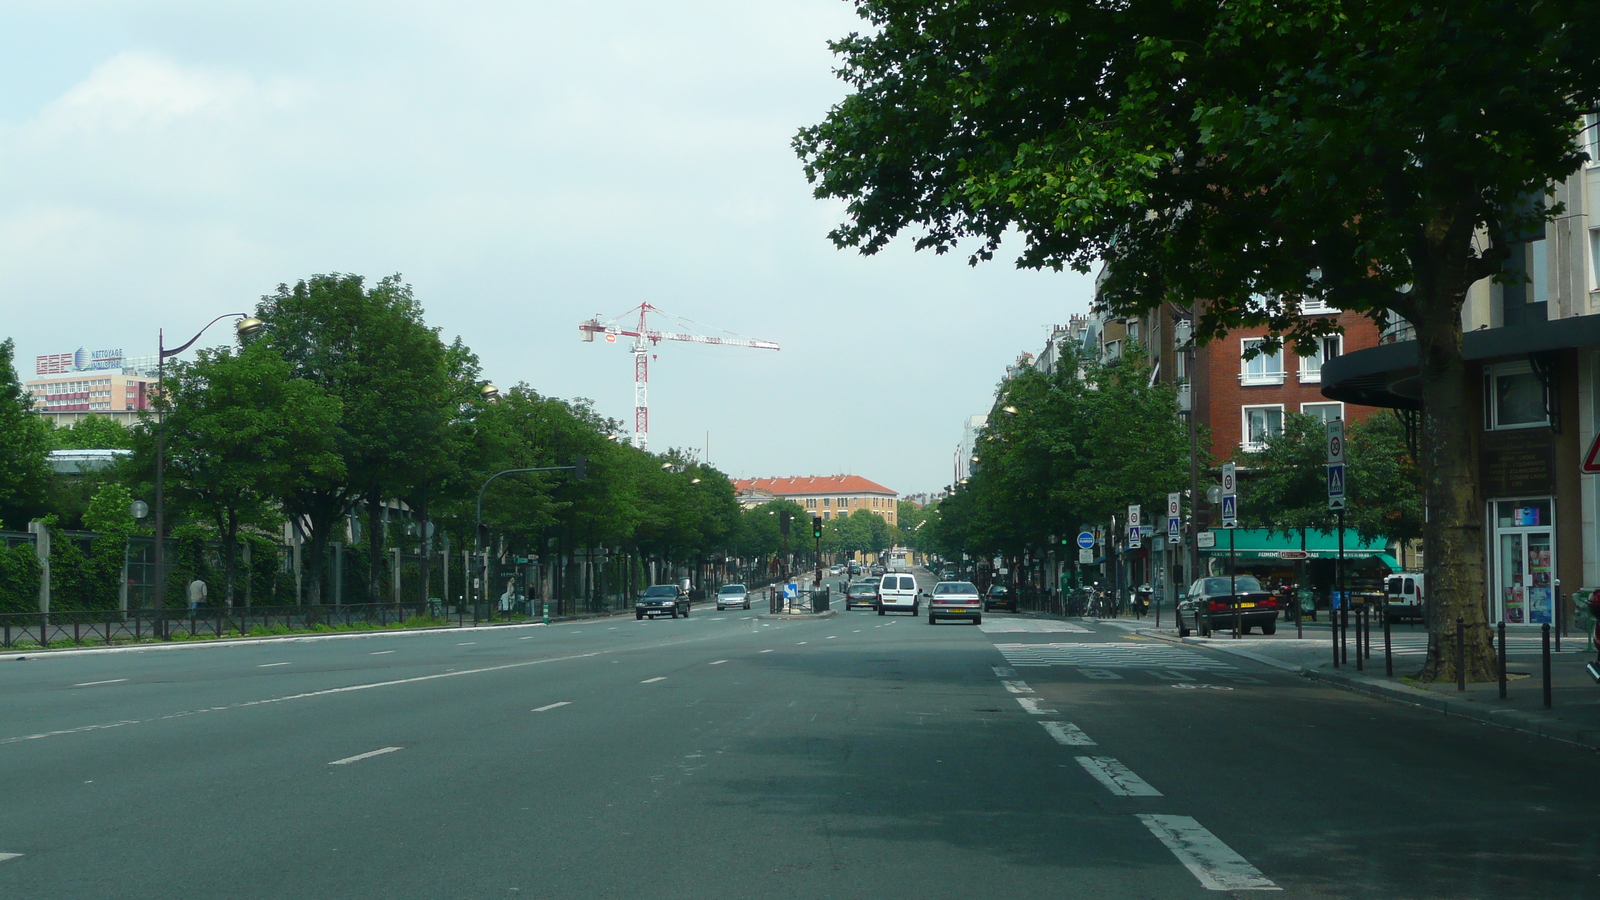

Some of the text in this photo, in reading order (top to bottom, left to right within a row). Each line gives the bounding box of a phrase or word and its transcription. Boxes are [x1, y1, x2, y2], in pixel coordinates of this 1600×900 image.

[91, 349, 122, 359] NETTOYAGE
[36, 353, 73, 375] GSF
[1332, 441, 1339, 451] 30
[1225, 478, 1232, 487] 30
[1076, 668, 1270, 684] BUS
